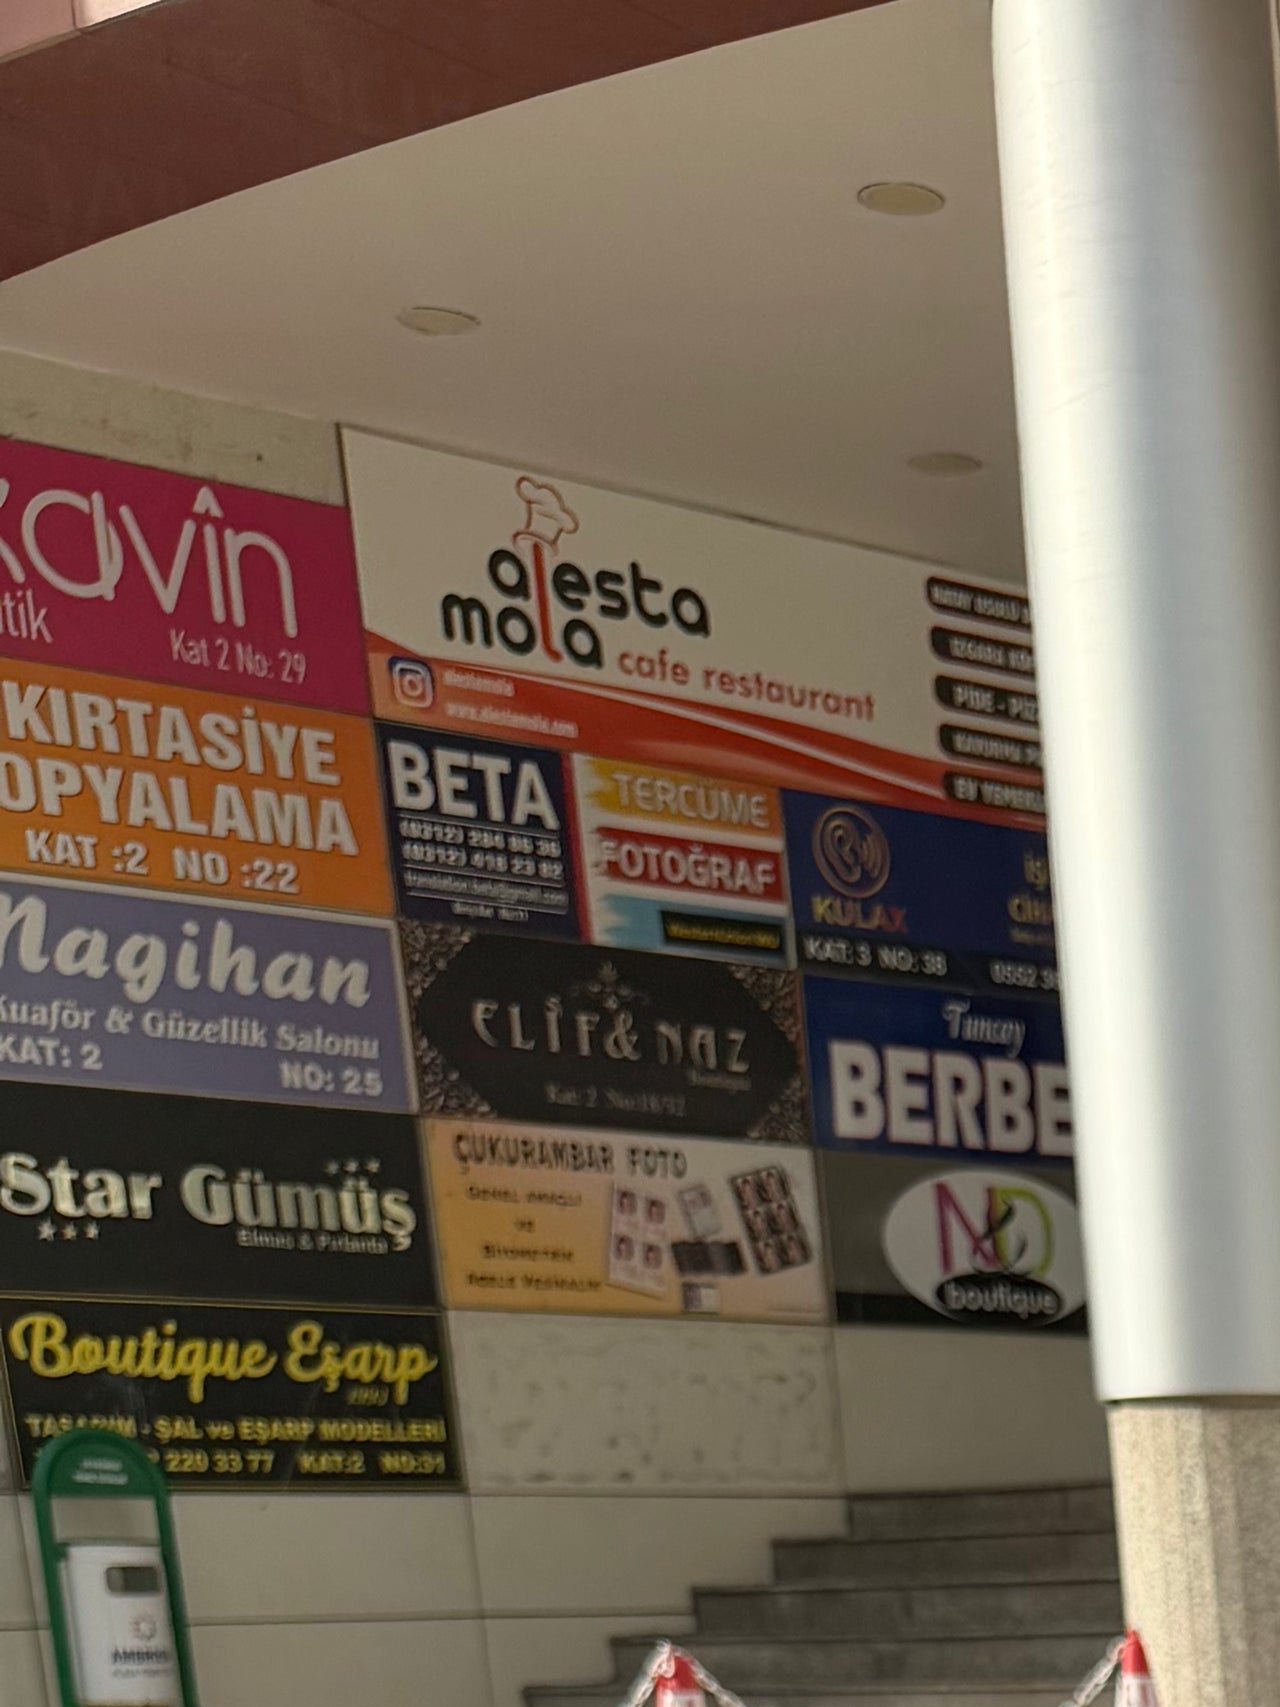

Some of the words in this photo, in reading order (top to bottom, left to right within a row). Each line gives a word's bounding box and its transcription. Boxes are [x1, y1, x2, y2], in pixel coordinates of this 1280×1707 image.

[0, 589, 53, 645] tik
[169, 628, 208, 664] Kat
[214, 640, 230, 671] 2
[236, 646, 274, 680] No:
[278, 652, 307, 685] 29
[617, 647, 690, 685] cafe
[702, 664, 876, 722] restaurant
[2, 679, 341, 787] KIRTASİYE
[386, 741, 561, 831] BETA
[612, 770, 771, 829] TERCÜME
[25, 829, 98, 869] KAT
[172, 847, 230, 887] NO
[600, 838, 777, 896] FOTOĞRAF
[104, 1005, 134, 1035] &
[141, 1009, 268, 1049] Güzellik
[274, 1023, 380, 1060] Salonu
[80, 1042, 103, 1071] 2
[279, 1062, 336, 1091] NO:
[341, 1068, 383, 1097] 25
[454, 1132, 614, 1175] ÇUKURAMBAR
[627, 1148, 688, 1178] FOTO
[0, 1151, 162, 1220] Star
[181, 1163, 417, 1253] Gümüş
[942, 1281, 1058, 1320] boutique
[9, 1312, 277, 1404] Boutique
[282, 1320, 439, 1405] Eşarp
[244, 1449, 274, 1474] 77
